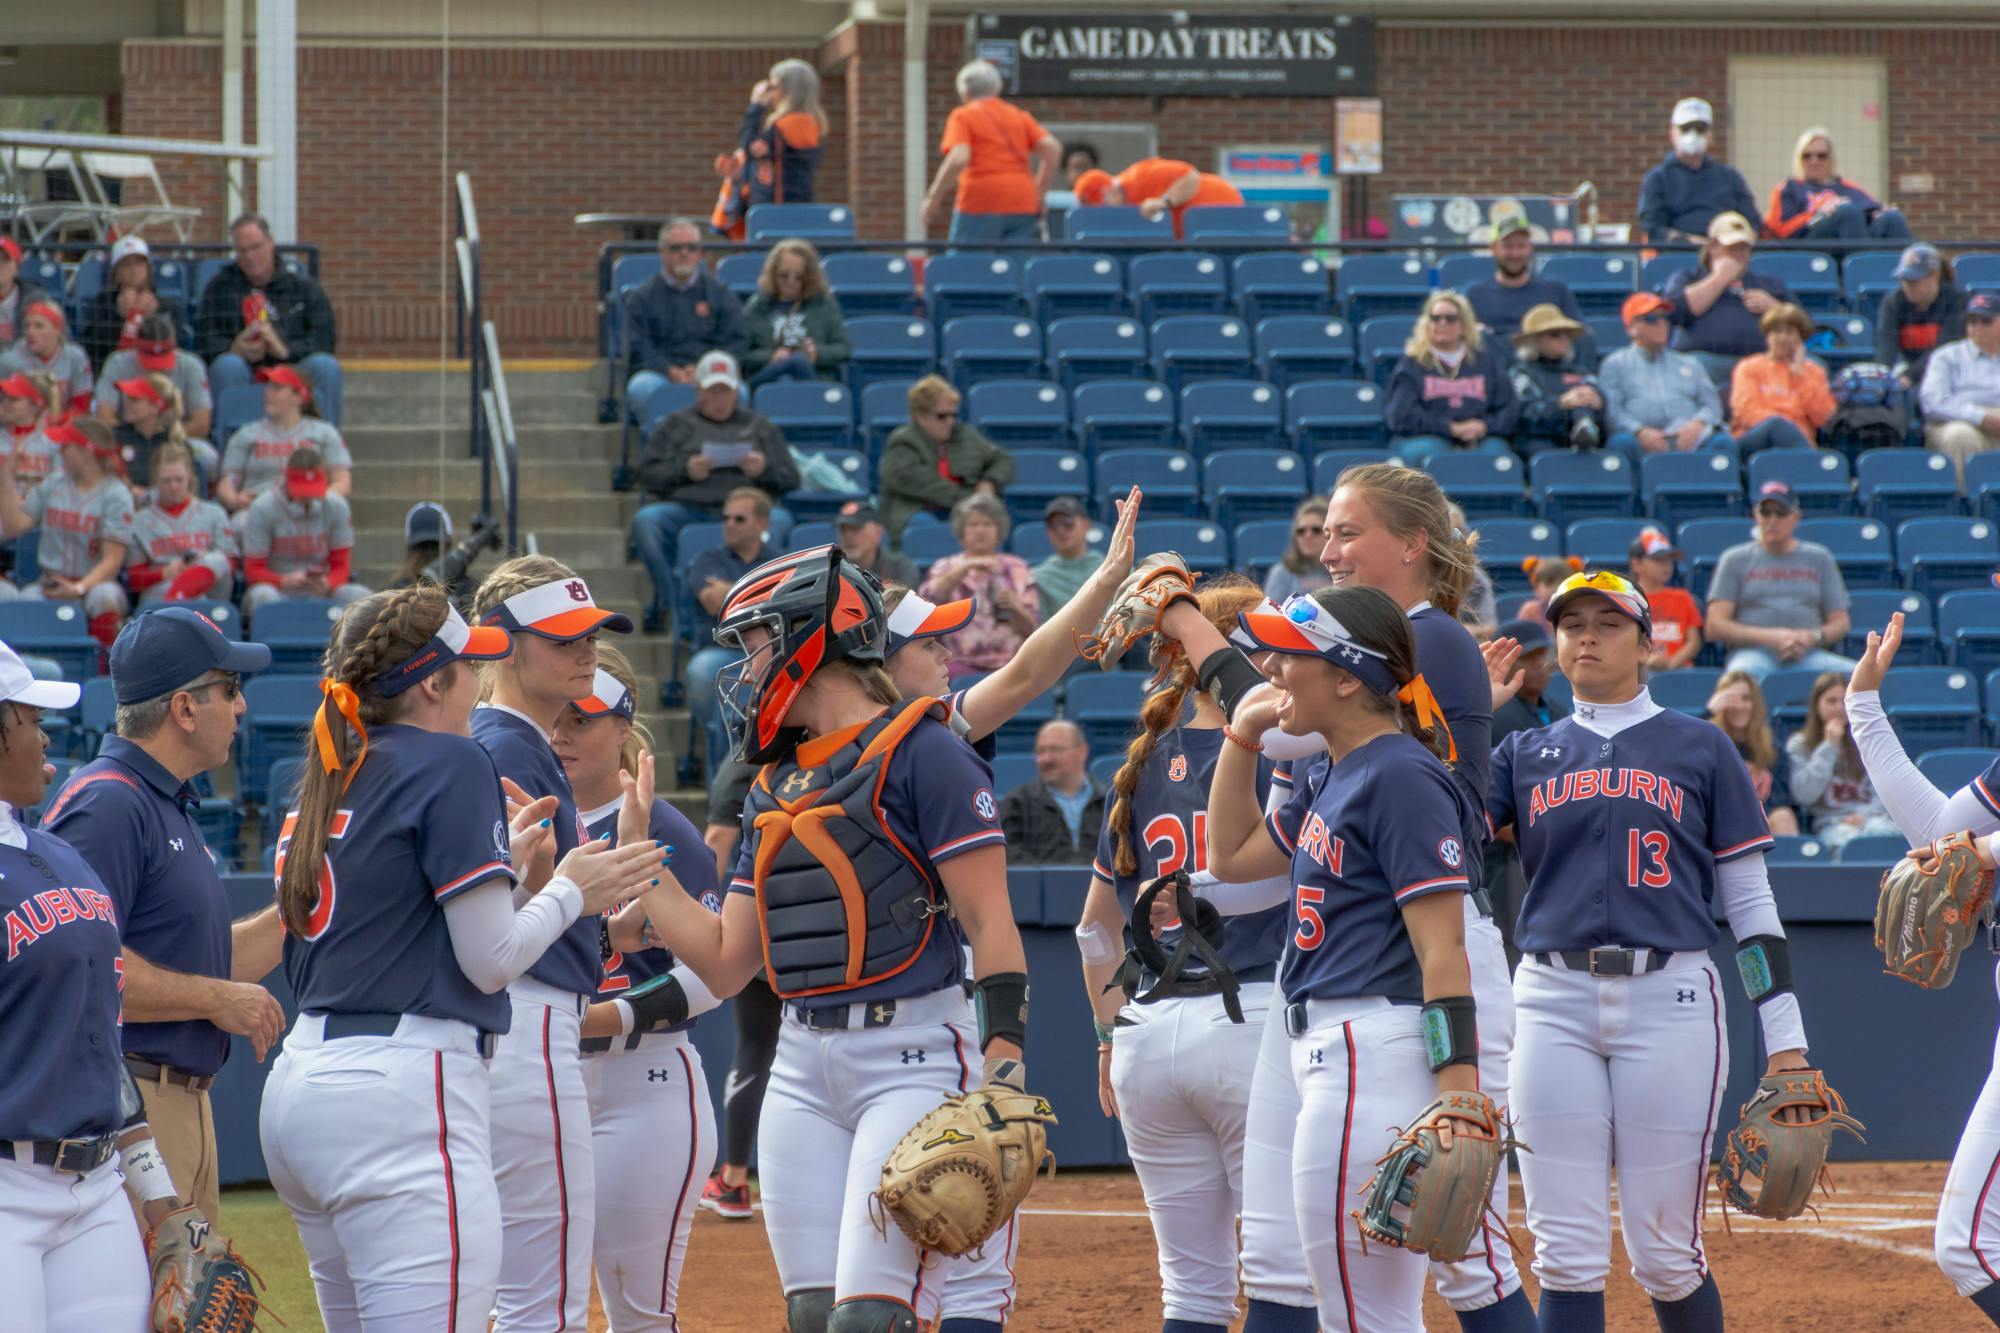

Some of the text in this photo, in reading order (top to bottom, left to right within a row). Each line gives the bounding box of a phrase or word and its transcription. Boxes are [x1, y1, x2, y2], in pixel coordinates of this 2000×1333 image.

[1203, 26, 1337, 60] TREATS
[402, 651, 439, 674] AUBURN
[975, 790, 996, 819] SEC
[1529, 767, 1684, 828] AUBURN
[1297, 810, 1345, 878] URN
[1440, 838, 1461, 867] SEC
[1628, 828, 1672, 888] 13
[1295, 884, 1325, 951] 5
